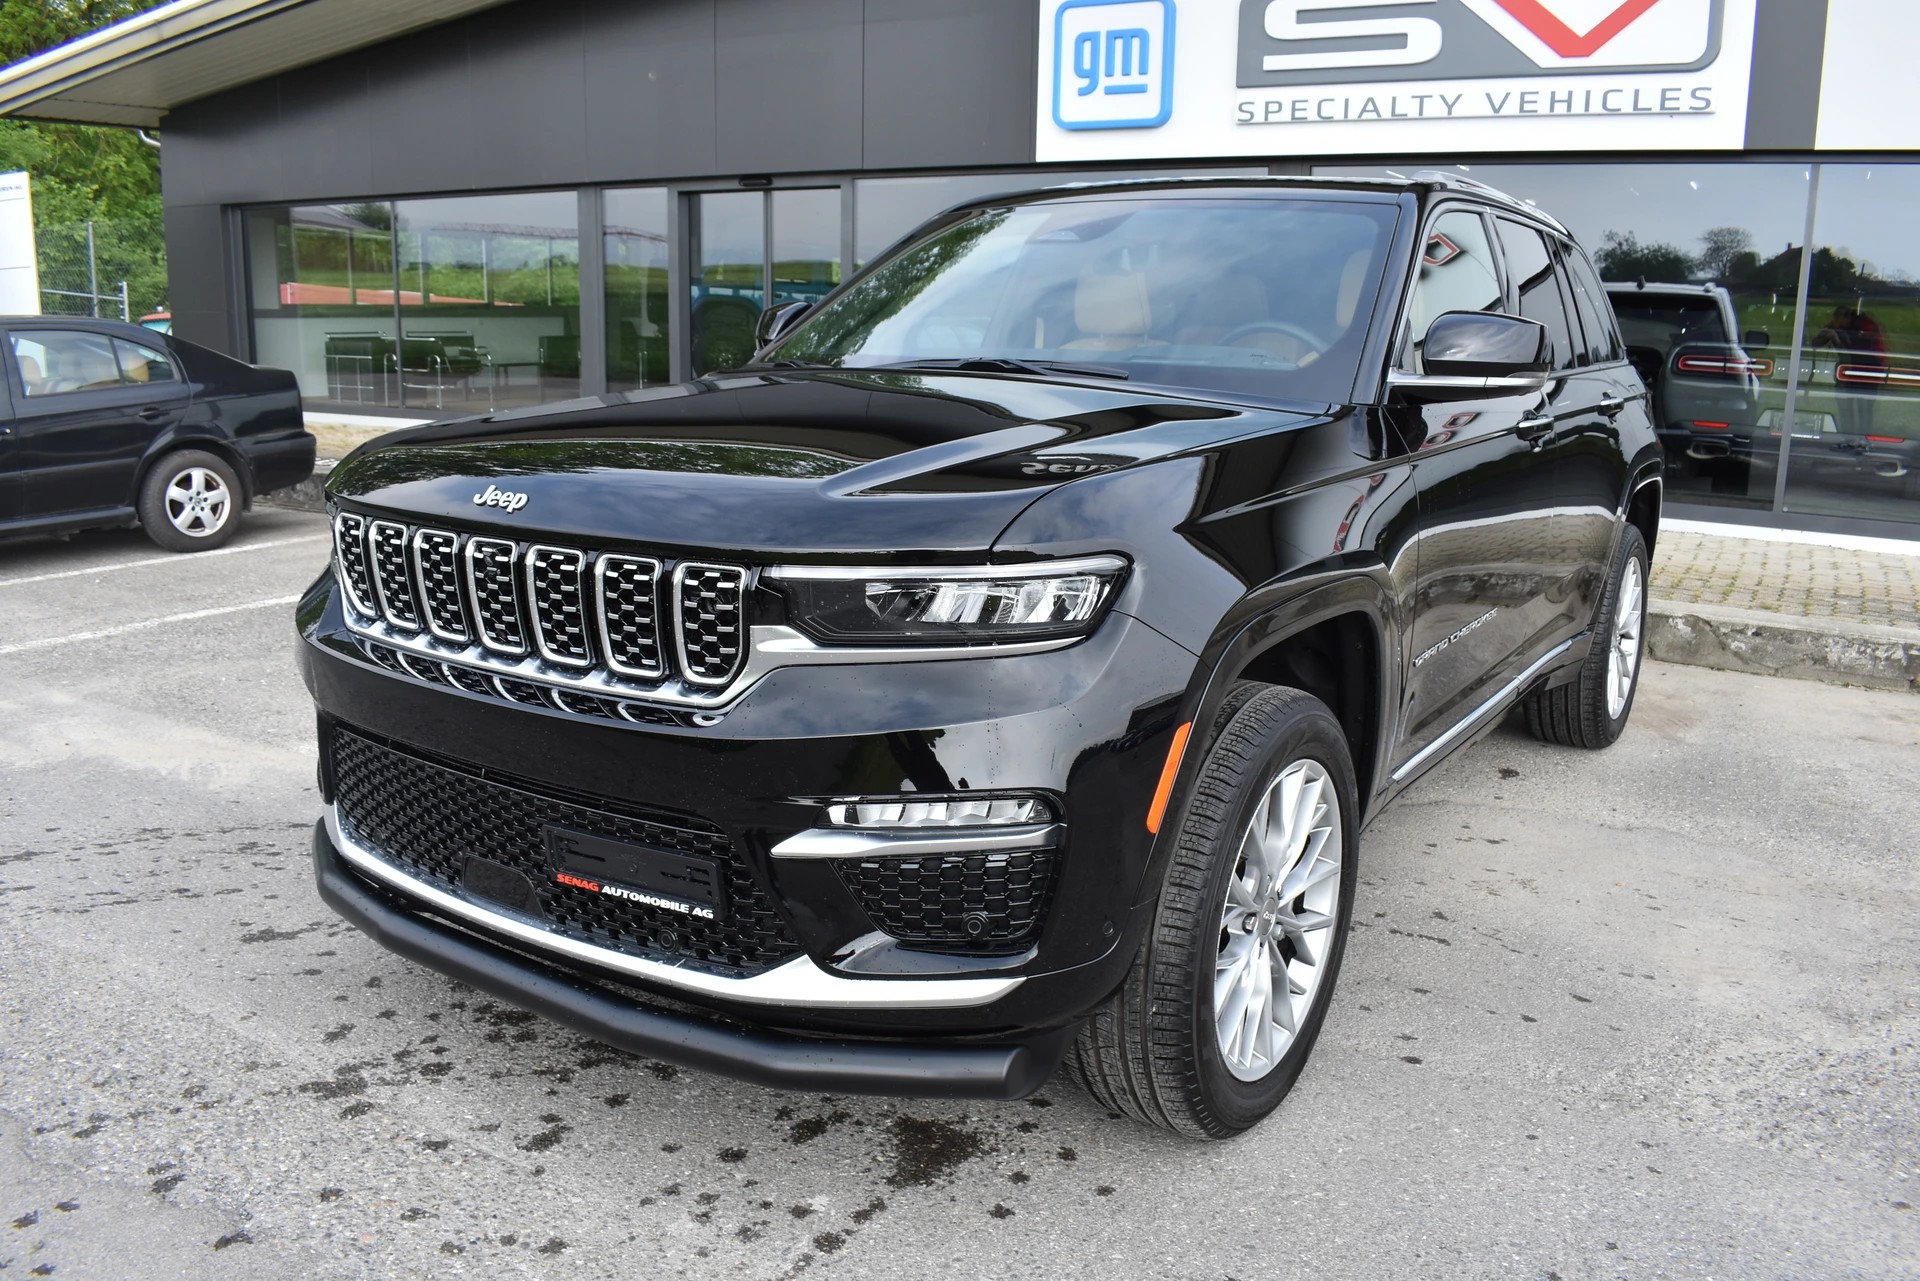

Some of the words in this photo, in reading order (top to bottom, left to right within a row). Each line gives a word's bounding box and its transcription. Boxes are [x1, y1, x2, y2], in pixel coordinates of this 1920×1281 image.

[1074, 28, 1150, 97] gm
[1237, 93, 1464, 123] SPECIALTY
[1485, 87, 1713, 115] VEHICLES
[473, 484, 528, 513] Jeep
[1414, 638, 1449, 667] GRAND
[1450, 607, 1498, 643] CHEROKEE
[556, 873, 600, 893] SENAG
[601, 884, 690, 914] AUTOMOBILE
[692, 906, 715, 919] AG
